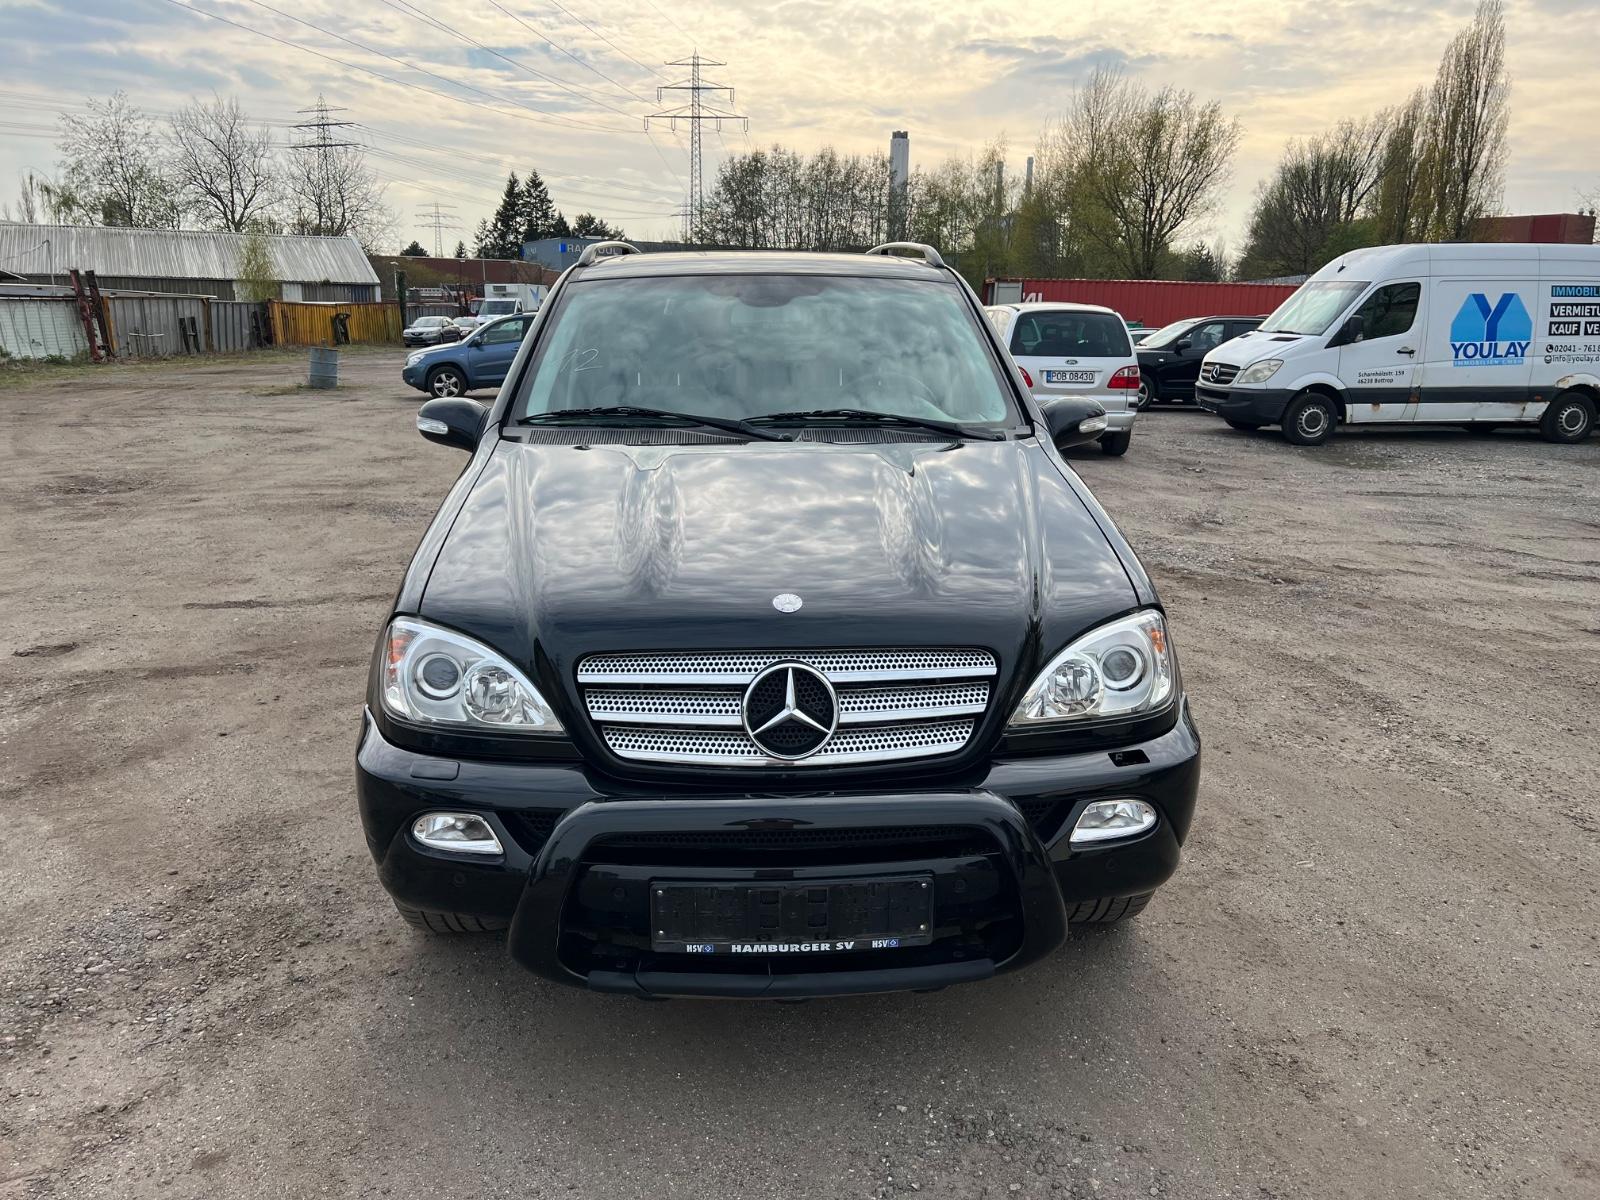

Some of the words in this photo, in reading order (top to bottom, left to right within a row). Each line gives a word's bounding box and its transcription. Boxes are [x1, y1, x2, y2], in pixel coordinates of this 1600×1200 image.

[1551, 323, 1578, 334] KAUF
[1451, 342, 1531, 358] YOULAY
[1554, 344, 1576, 352] 02041
[1052, 372, 1067, 380] POB
[1069, 372, 1094, 380] 08430
[686, 944, 704, 953] HSV
[731, 943, 831, 953] HAMBURGER
[836, 941, 855, 950] SV
[872, 940, 889, 948] HSV
